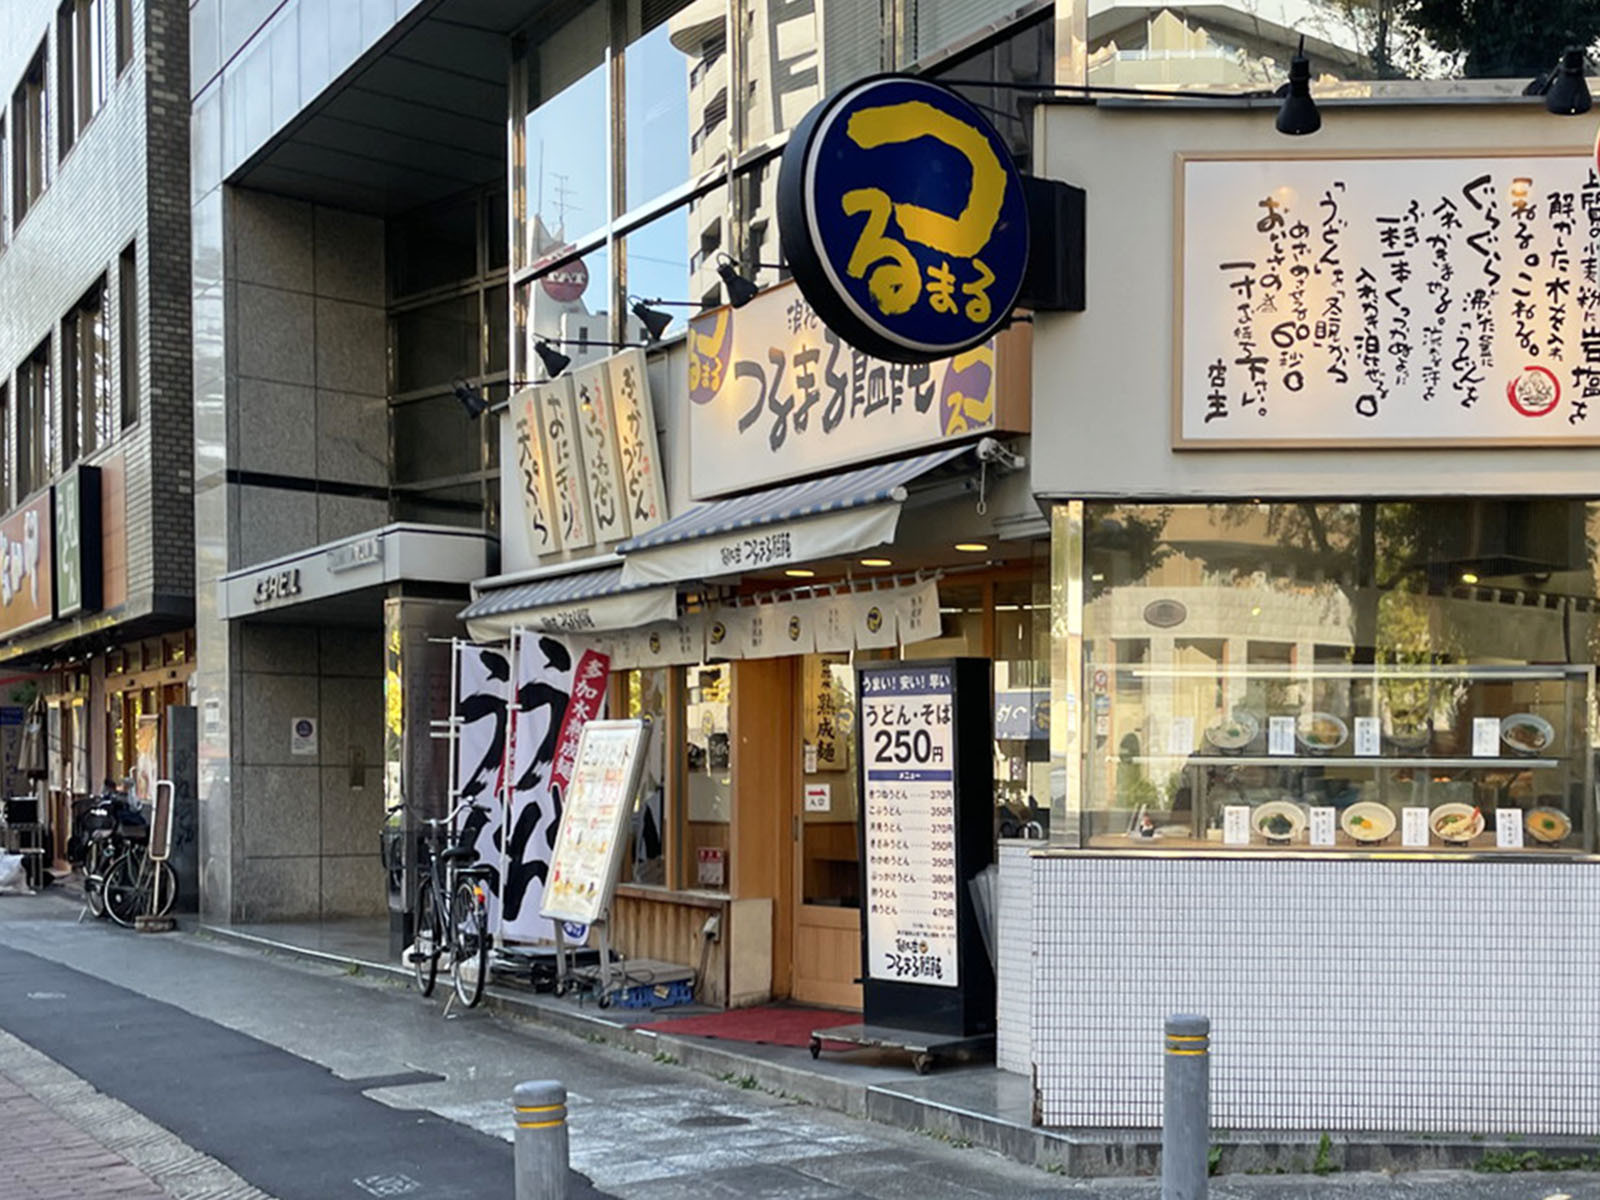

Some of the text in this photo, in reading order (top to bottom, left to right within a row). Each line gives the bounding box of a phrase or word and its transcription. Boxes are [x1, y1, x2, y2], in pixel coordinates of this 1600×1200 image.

[842, 101, 1008, 323] つるまる
[1204, 359, 1228, 423] 店主
[866, 703, 951, 727] うどん・そば
[874, 729, 943, 763] 250円
[871, 887, 898, 898] うどん
